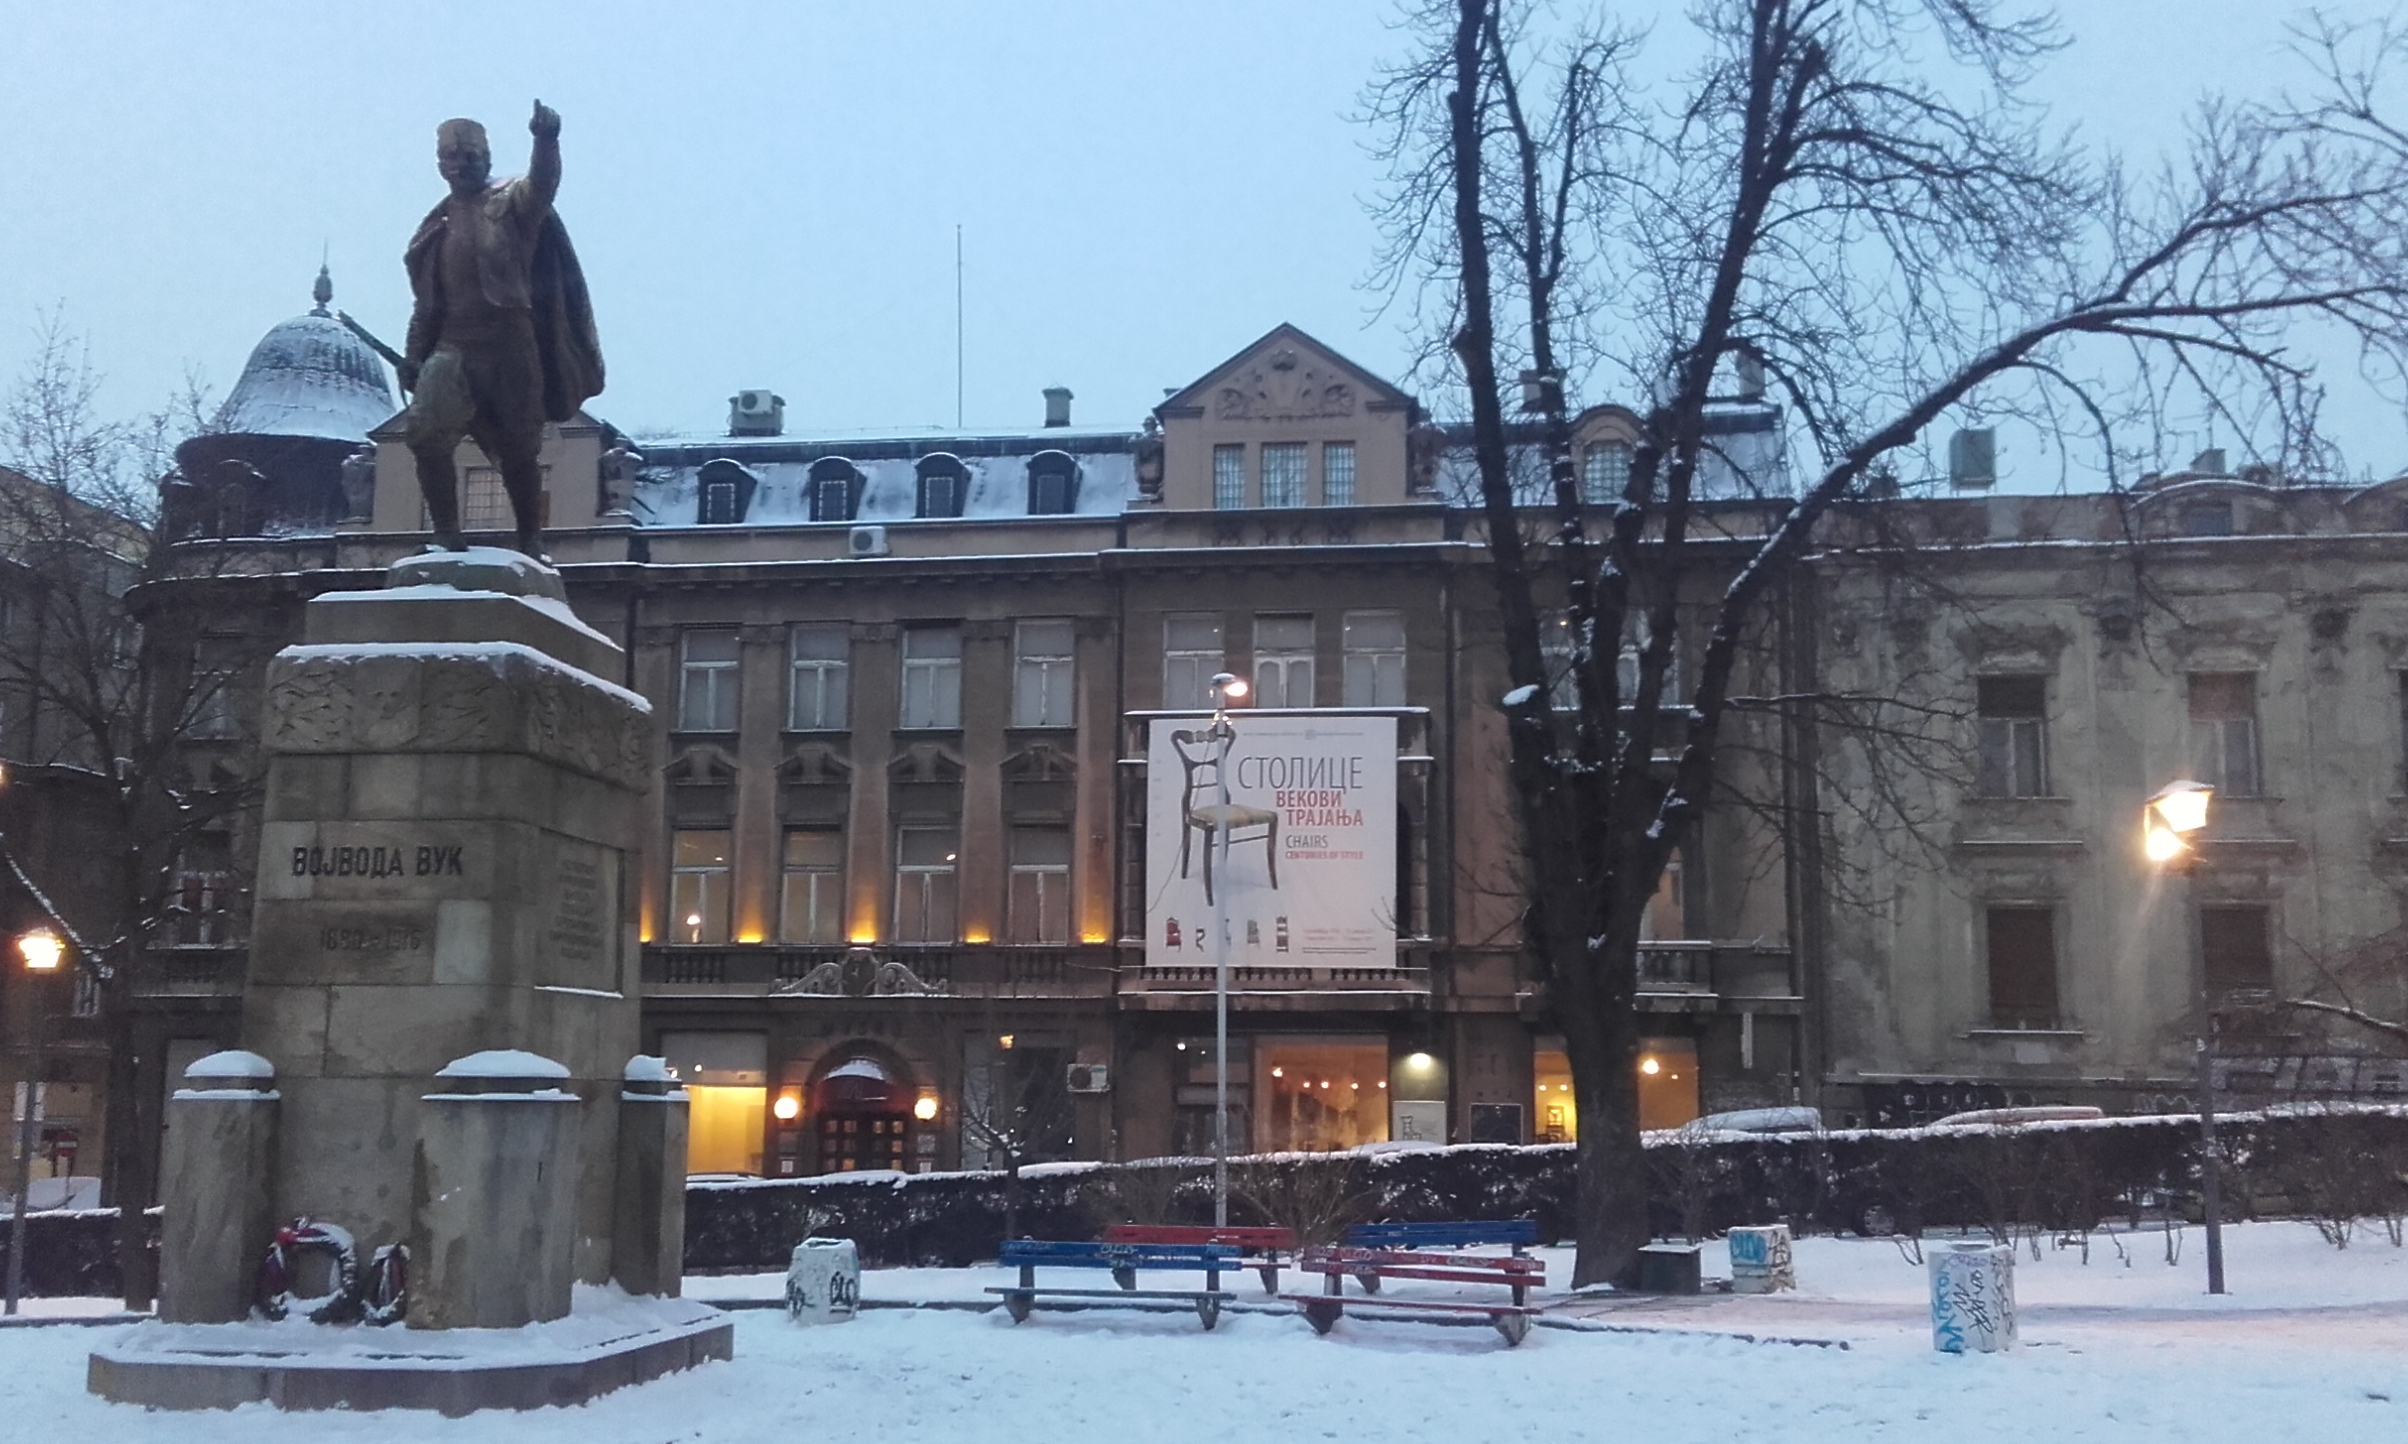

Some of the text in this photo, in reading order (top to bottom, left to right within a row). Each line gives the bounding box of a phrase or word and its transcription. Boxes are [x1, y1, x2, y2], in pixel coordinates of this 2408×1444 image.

[1238, 757, 1363, 794] СТОЛИЦЕ
[1276, 790, 1341, 808] ВЕКОВИ
[1286, 809, 1363, 826] ТРАЈАЊА
[1285, 834, 1329, 849] CHAIRS
[291, 845, 463, 878] ВОЈВОДА ВУК
